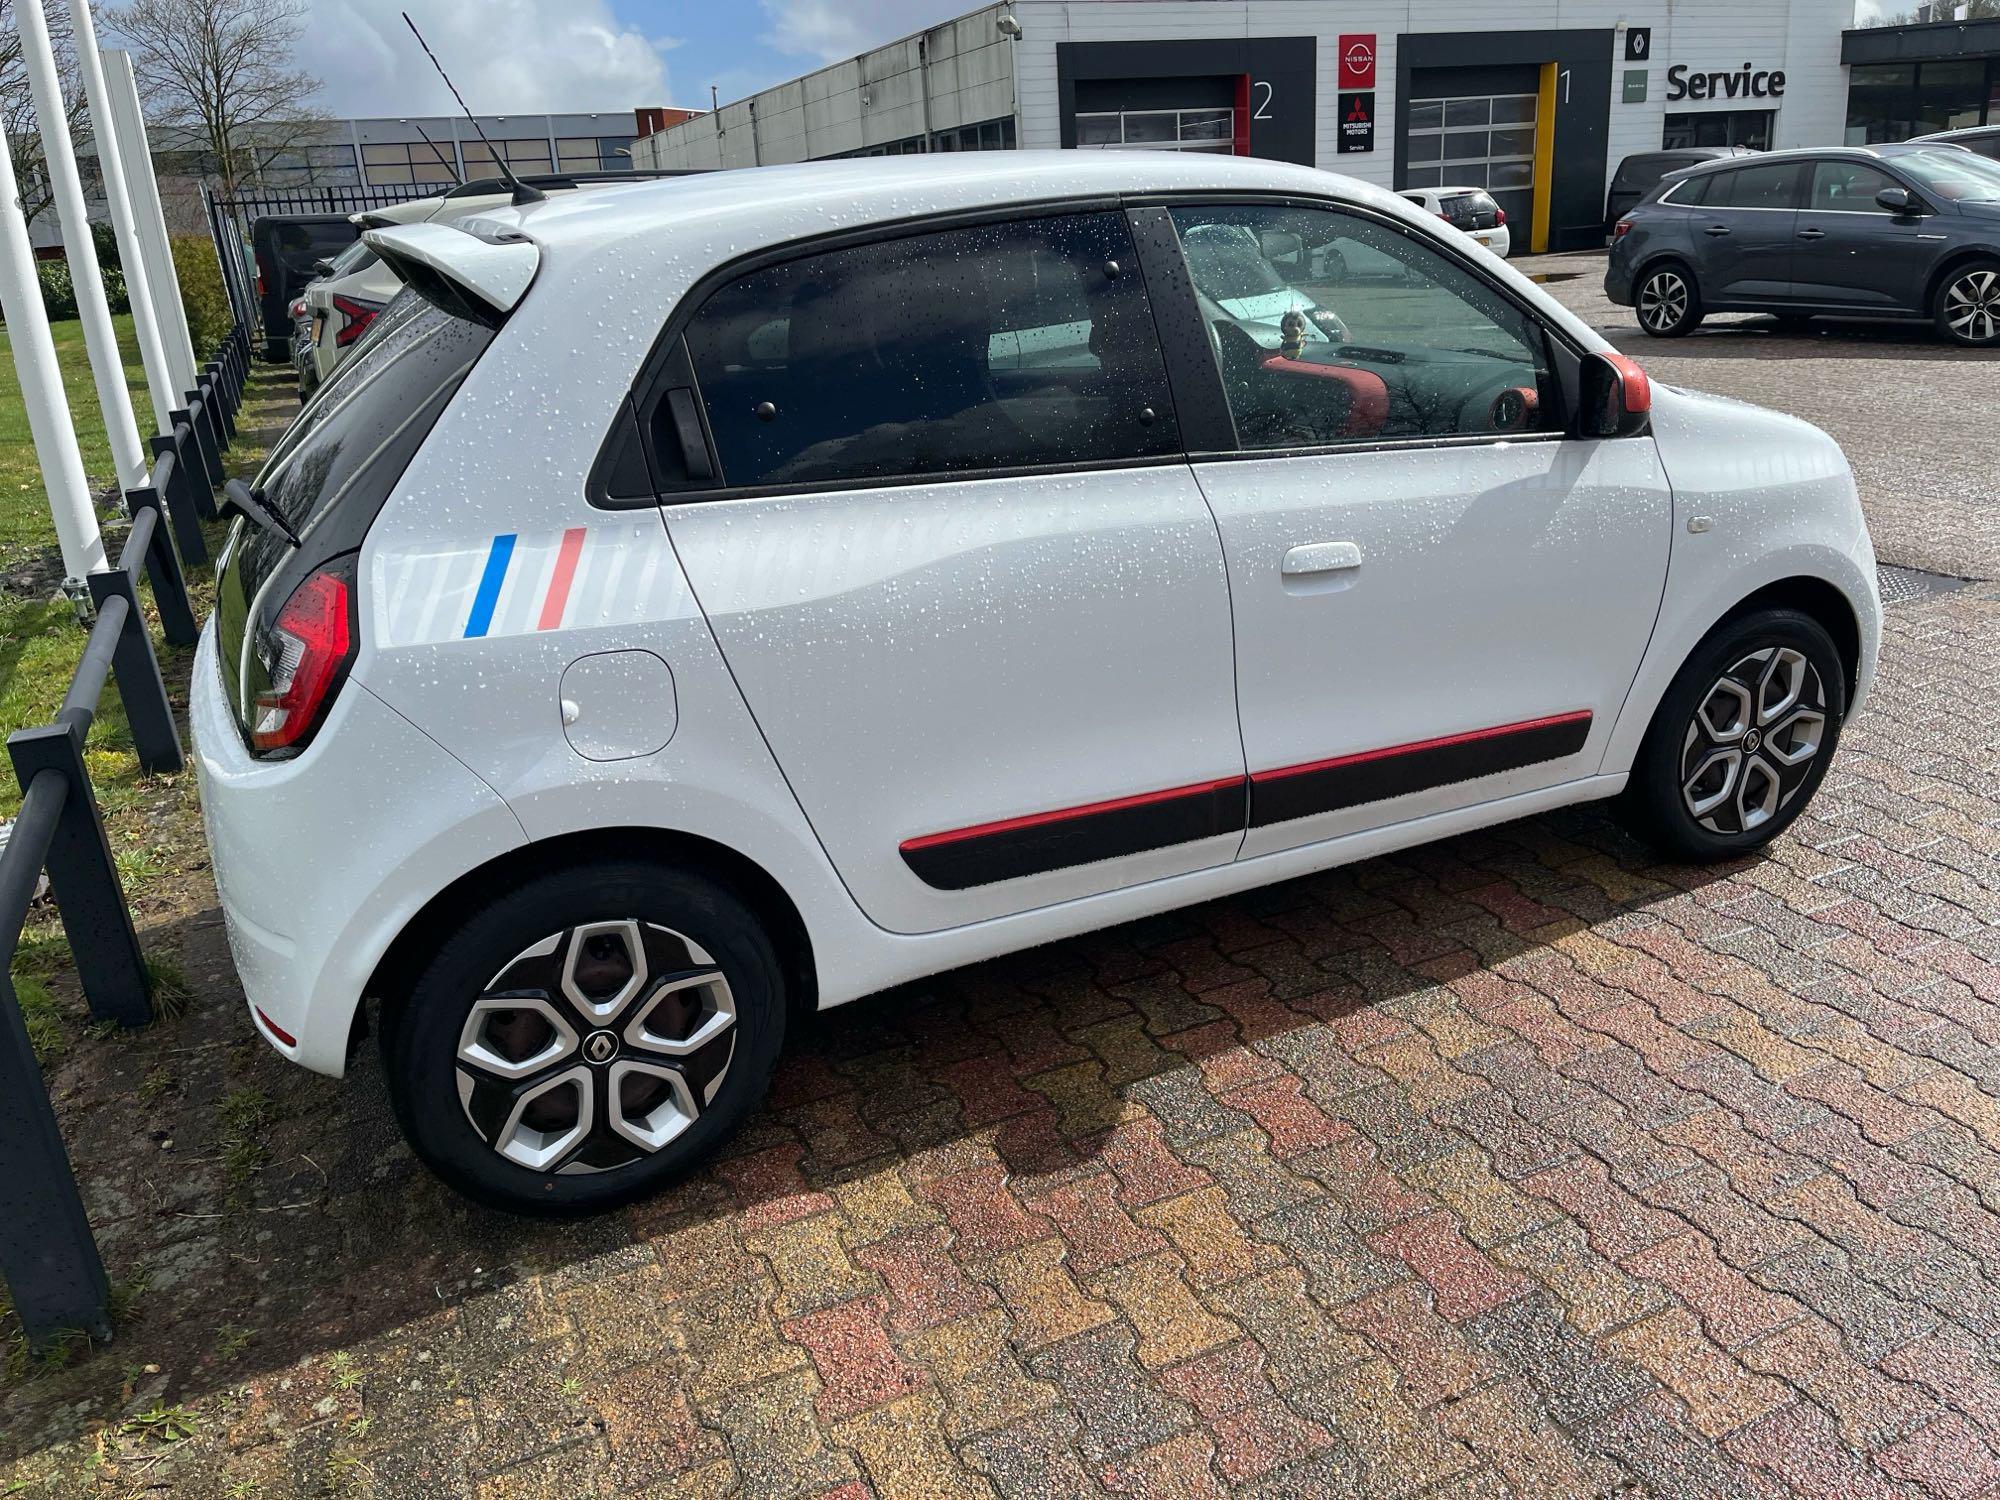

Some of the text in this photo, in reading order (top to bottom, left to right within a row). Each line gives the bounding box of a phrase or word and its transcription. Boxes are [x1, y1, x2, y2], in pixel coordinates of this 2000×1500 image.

[1345, 55, 1374, 63] NISSAN
[1560, 70, 1570, 104] 1
[1666, 62, 1786, 101] Service
[1254, 81, 1273, 120] 2
[1343, 122, 1372, 130] MITSUBISHI
